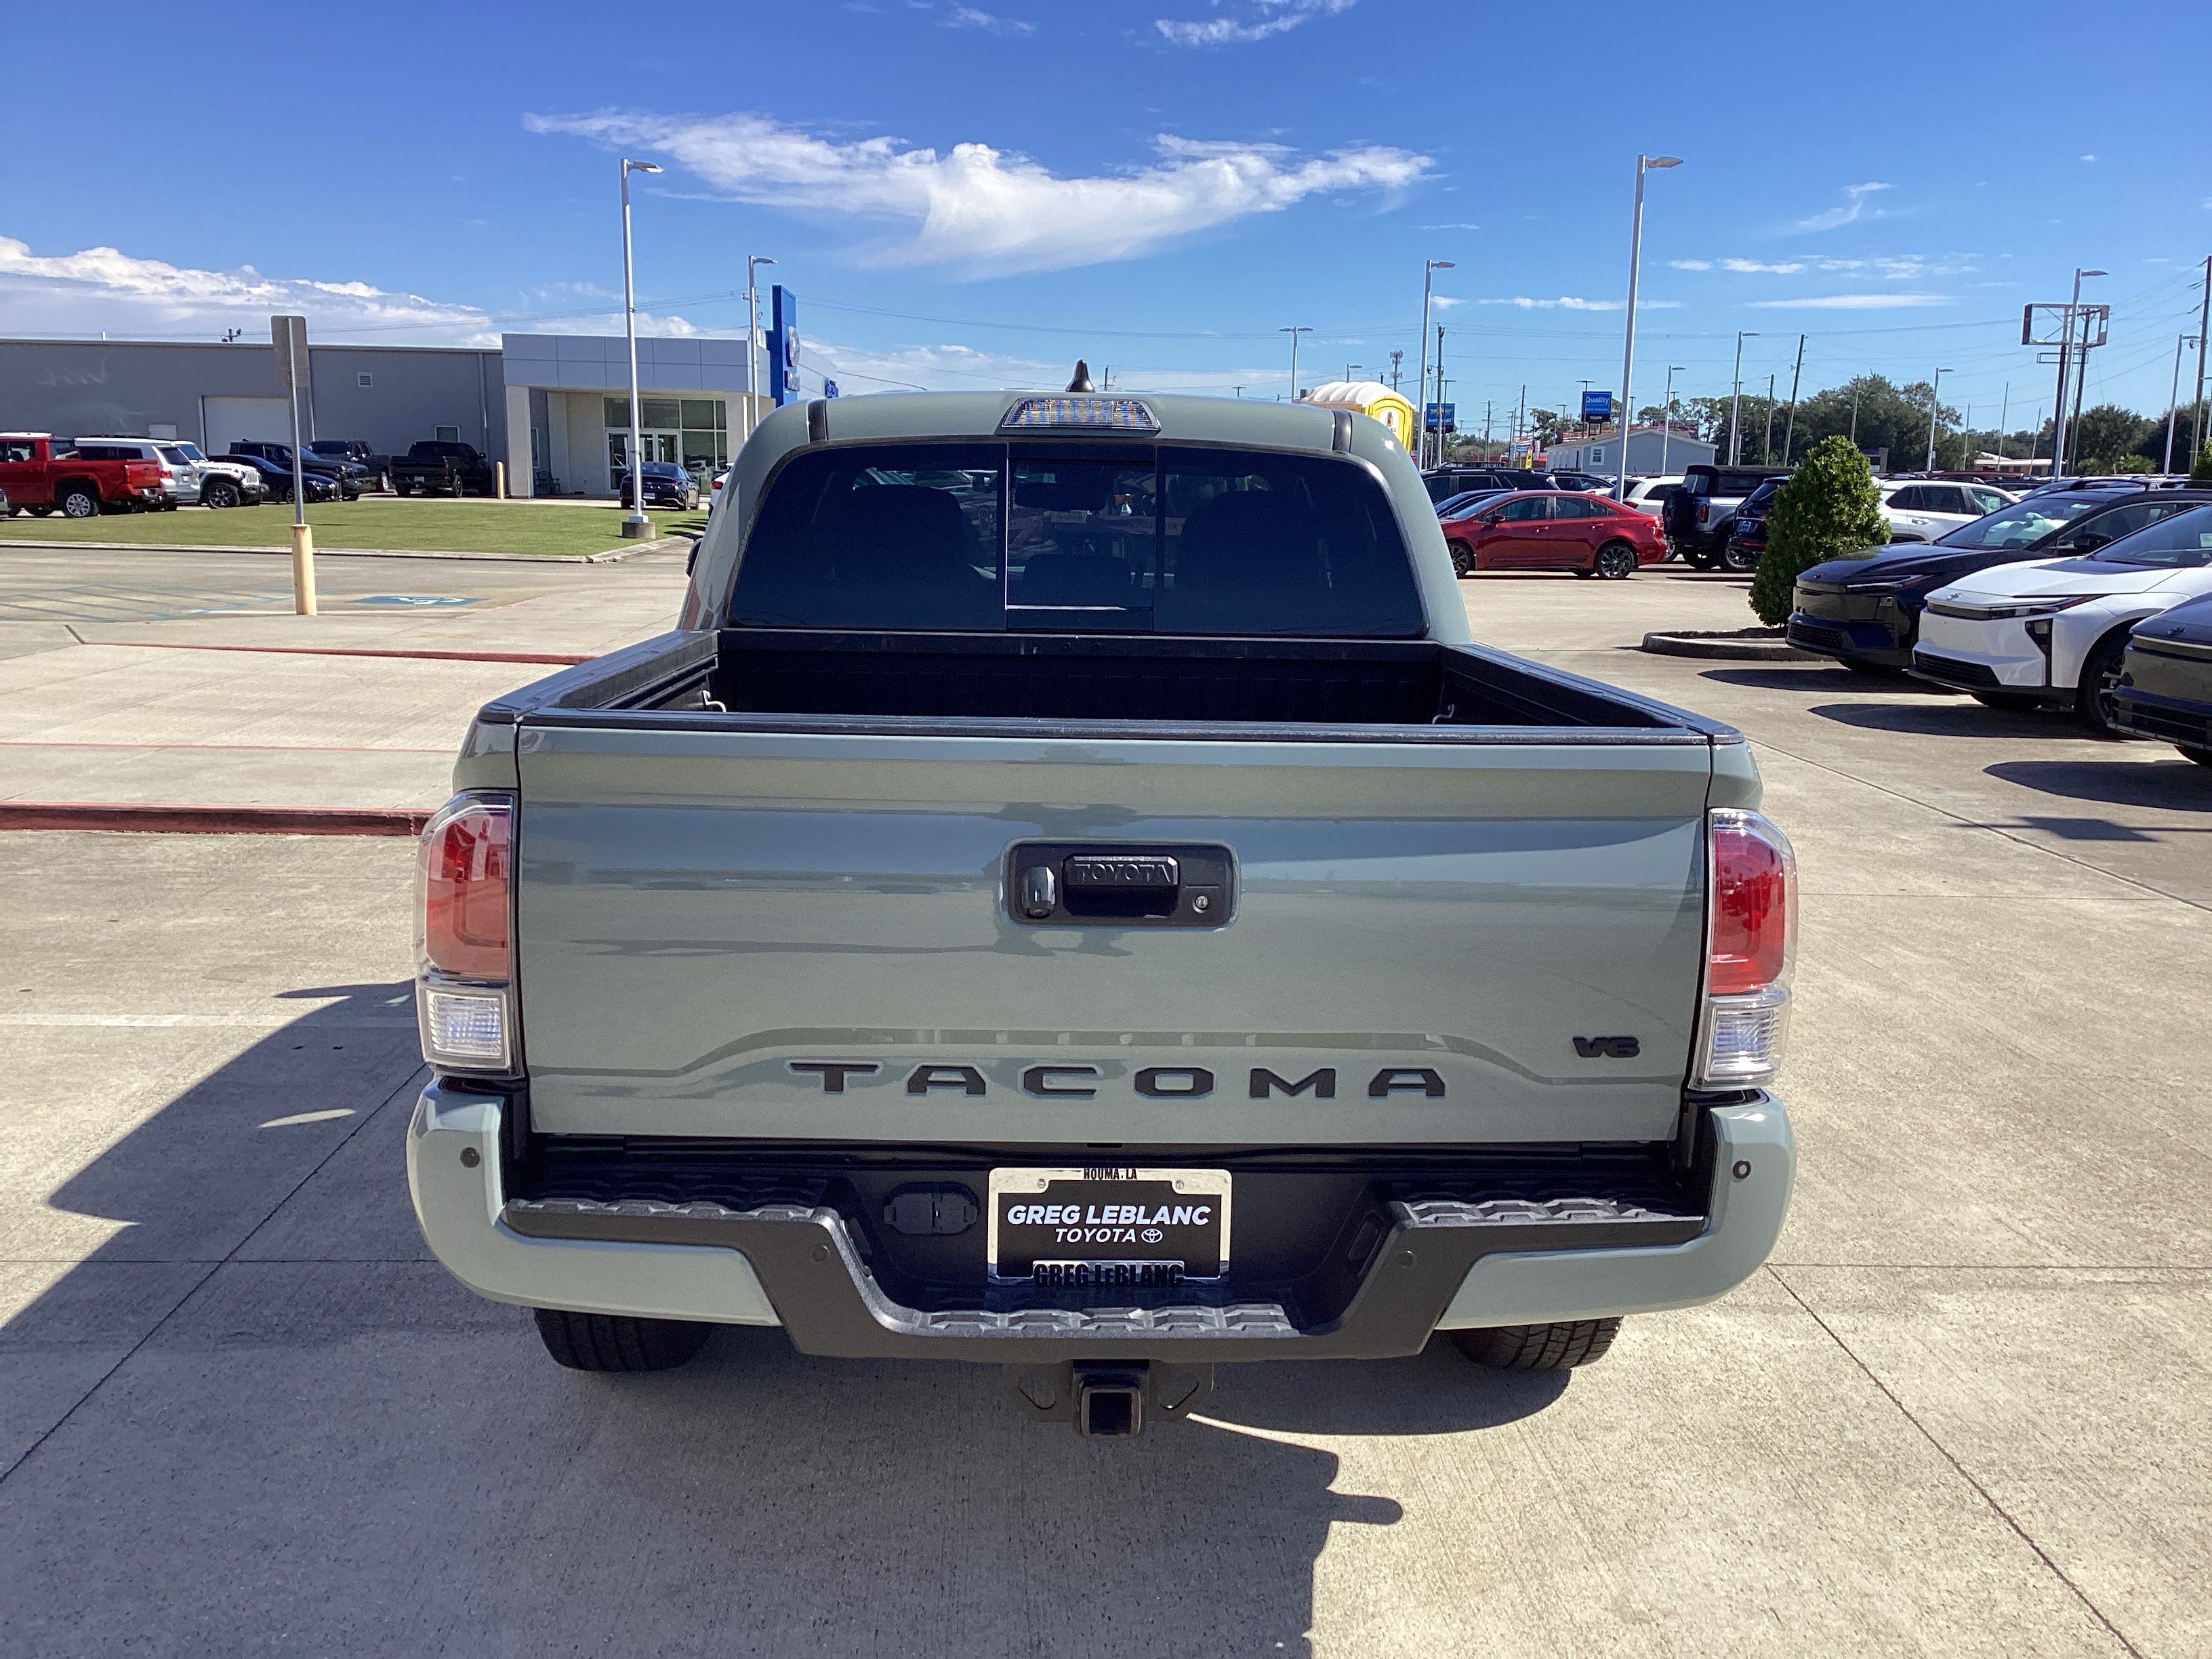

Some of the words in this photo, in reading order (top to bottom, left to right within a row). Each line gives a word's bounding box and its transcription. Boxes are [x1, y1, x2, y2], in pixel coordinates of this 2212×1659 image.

[1586, 396, 1610, 405] Quality
[1074, 863, 1170, 882] TOYOTA
[1572, 1037, 1641, 1057] V6
[789, 1062, 1446, 1099] TACOMA
[1126, 1168, 1137, 1180] LA
[1007, 1205, 1081, 1225] GREG
[1085, 1205, 1212, 1226] LEBLANC
[1055, 1228, 1136, 1243] TOYOTA
[1033, 1263, 1089, 1287] GREG
